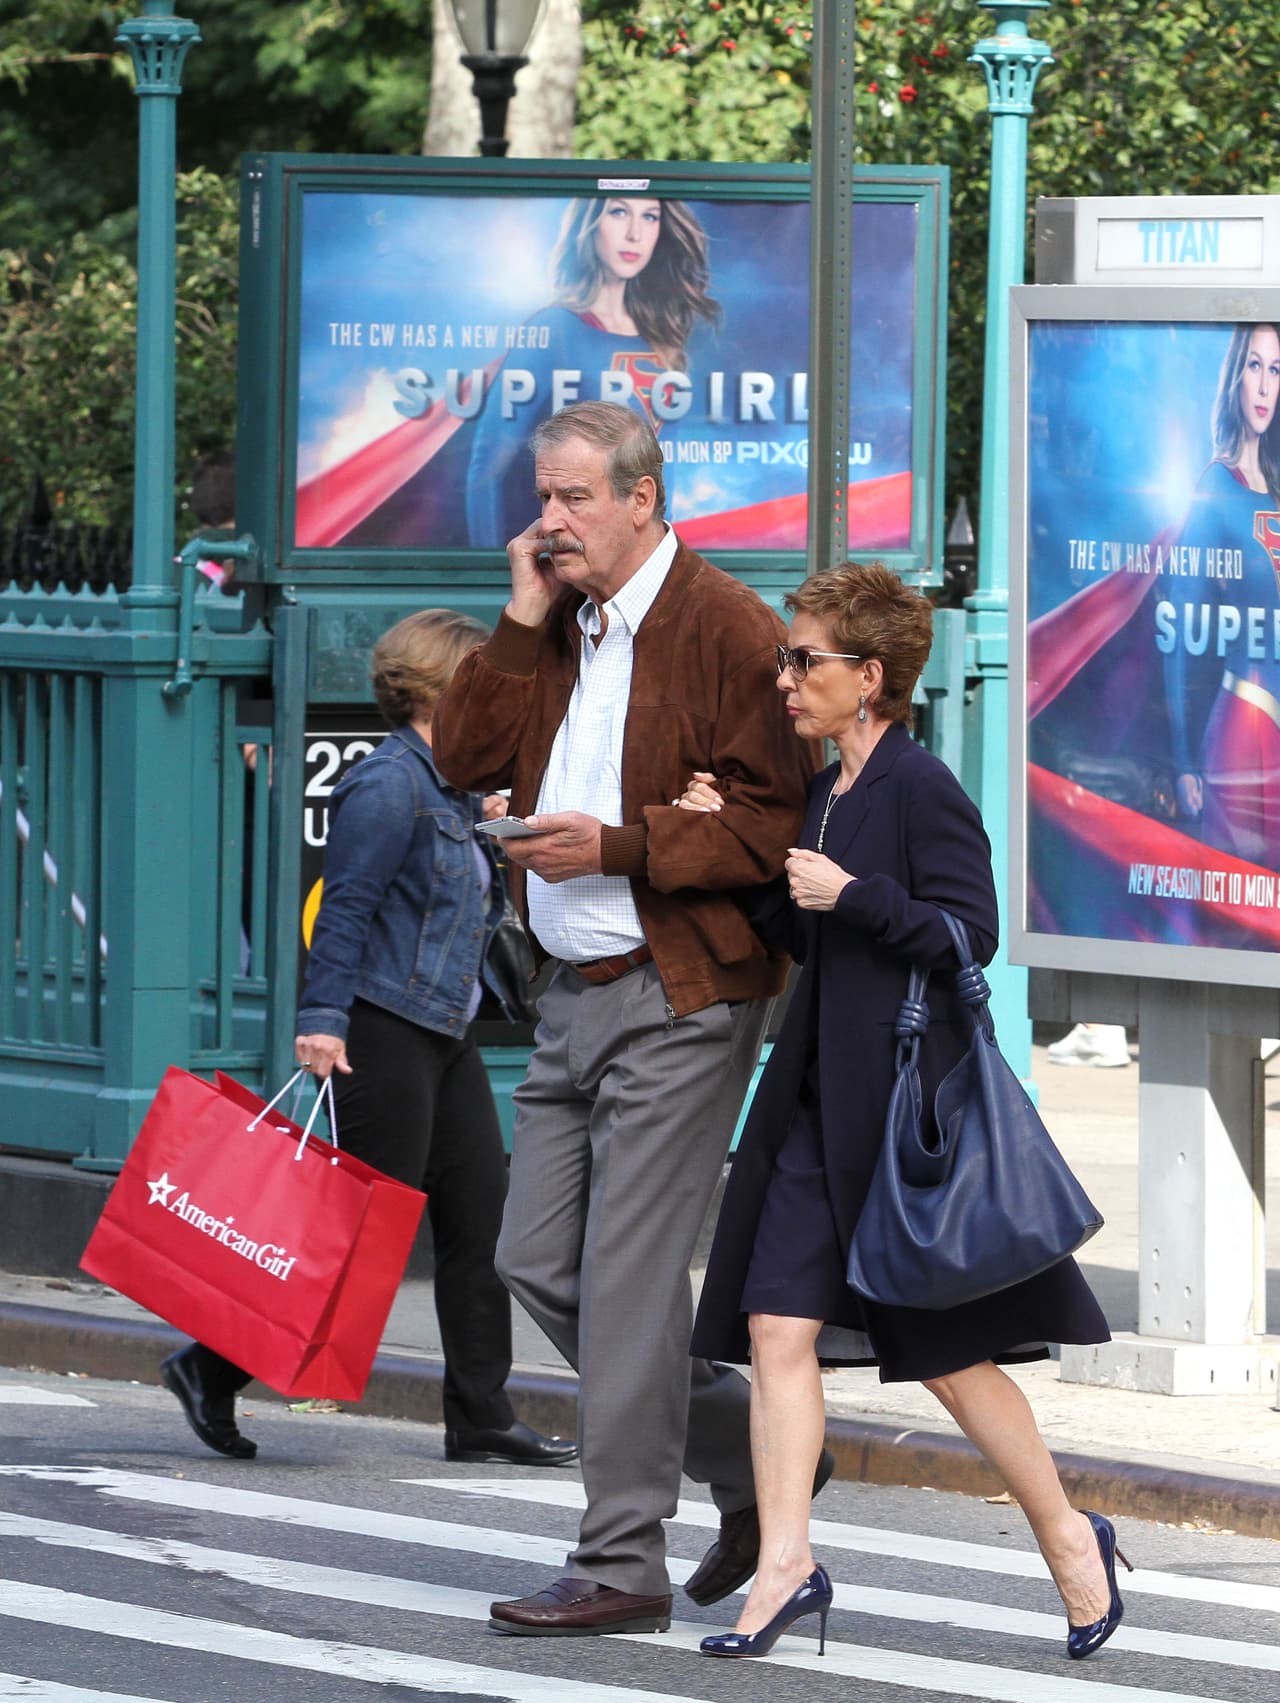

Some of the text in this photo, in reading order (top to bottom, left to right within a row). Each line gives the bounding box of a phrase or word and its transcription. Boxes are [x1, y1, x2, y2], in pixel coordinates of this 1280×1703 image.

[1138, 219, 1221, 263] TITAN
[329, 322, 550, 349] THE CW HAS A NEW HERO
[677, 440, 710, 464] MON
[713, 440, 732, 464] 8P
[1069, 539, 1243, 580] THE CW HAS A NEW HERO
[1128, 863, 1155, 895] NEW
[1155, 865, 1202, 900] SEASON
[1203, 870, 1226, 903] OCT
[1228, 872, 1241, 905] 10
[1245, 874, 1275, 908] MON
